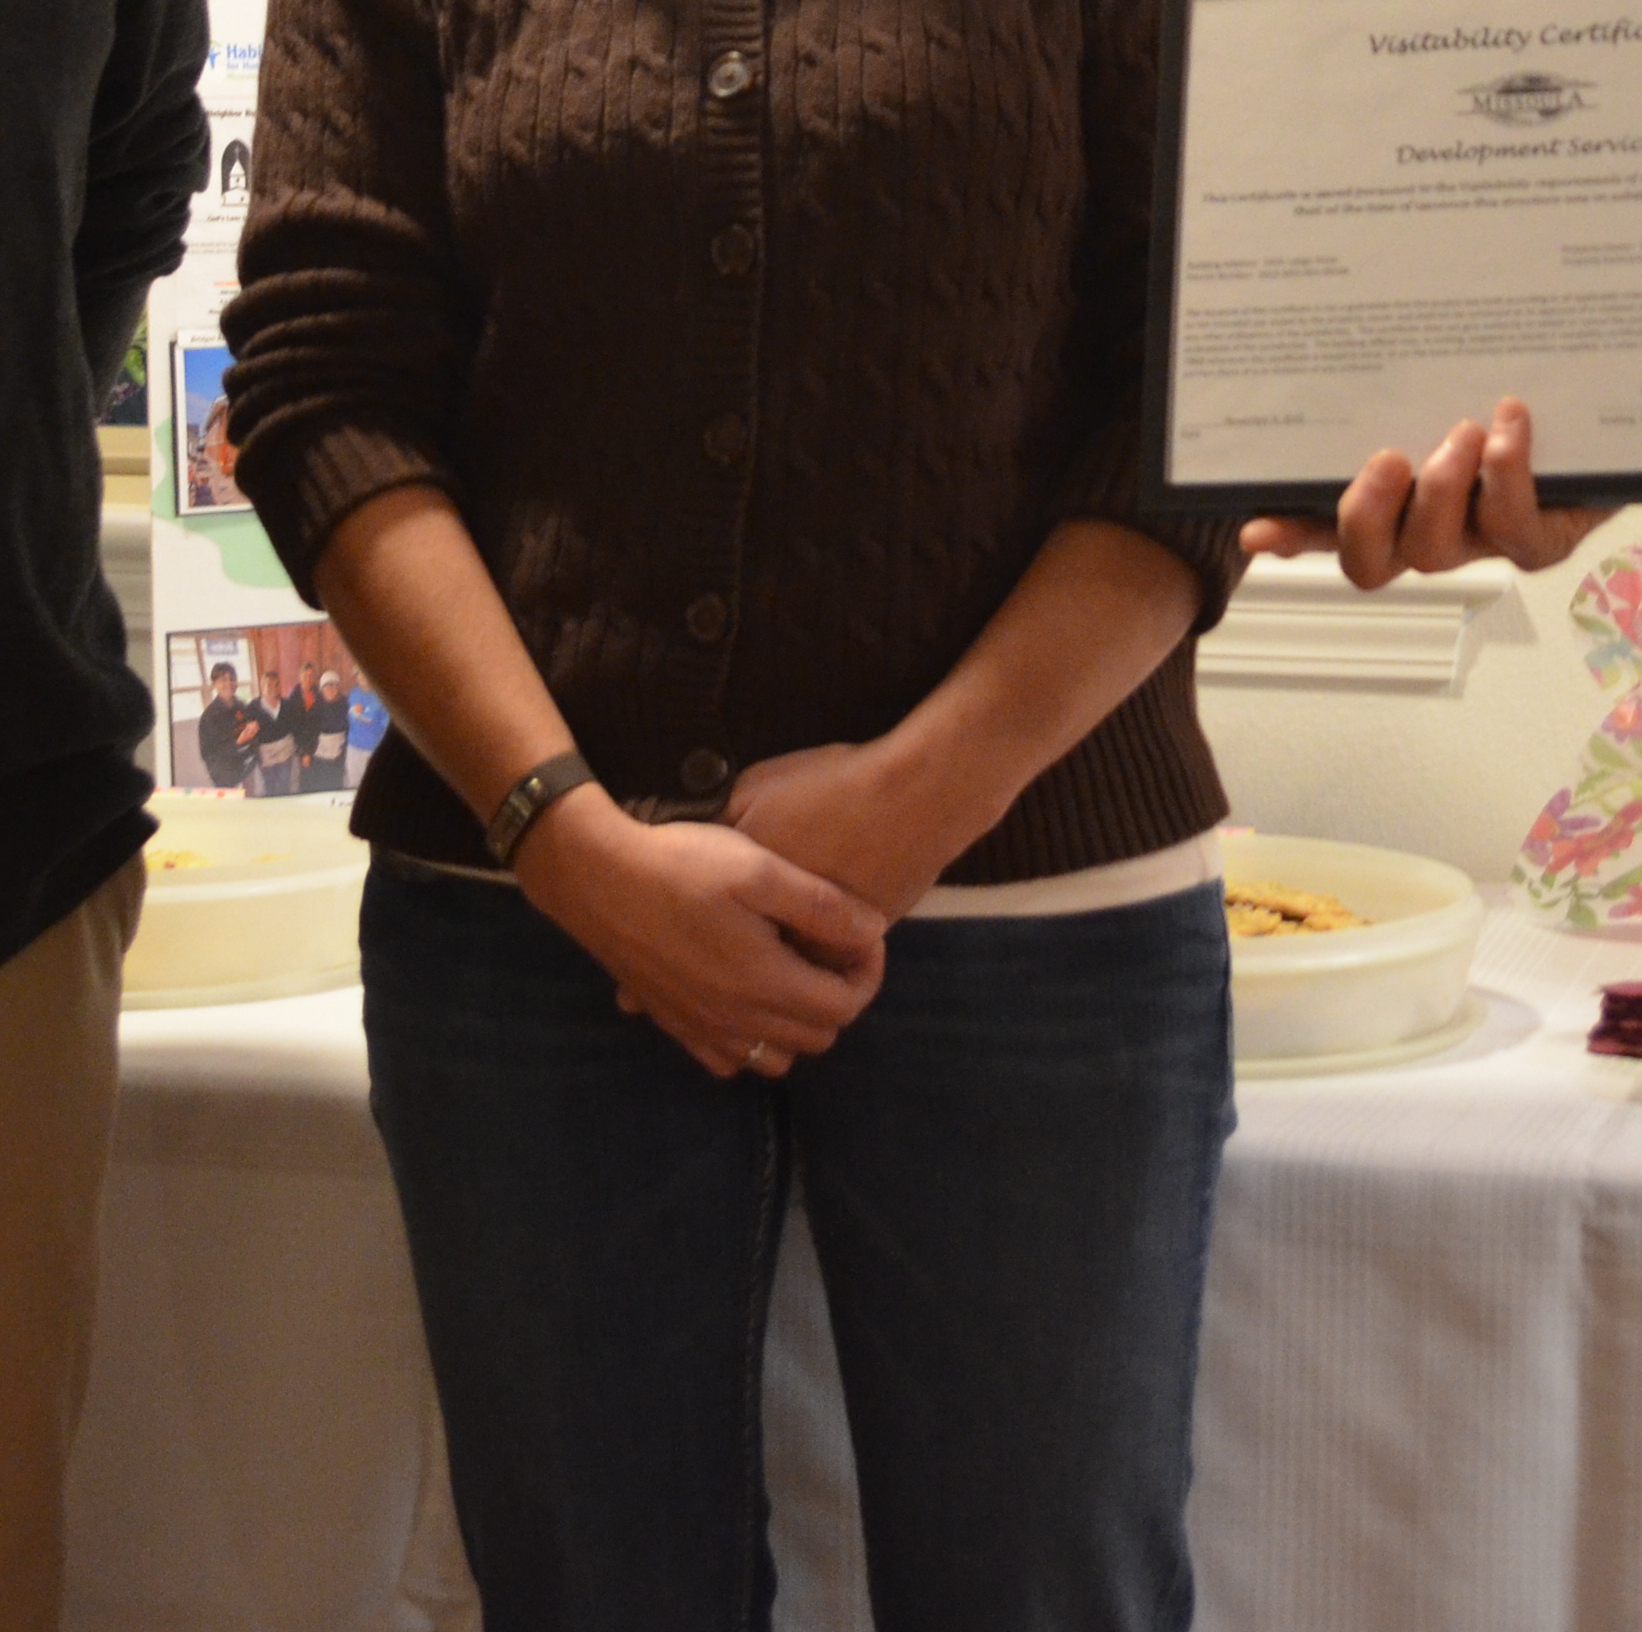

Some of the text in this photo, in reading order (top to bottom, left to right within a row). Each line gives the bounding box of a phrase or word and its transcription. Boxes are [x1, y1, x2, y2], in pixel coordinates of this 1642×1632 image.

[227, 44, 263, 60] Habi
[1369, 26, 1532, 56] Visitability
[1396, 138, 1560, 166] Development
